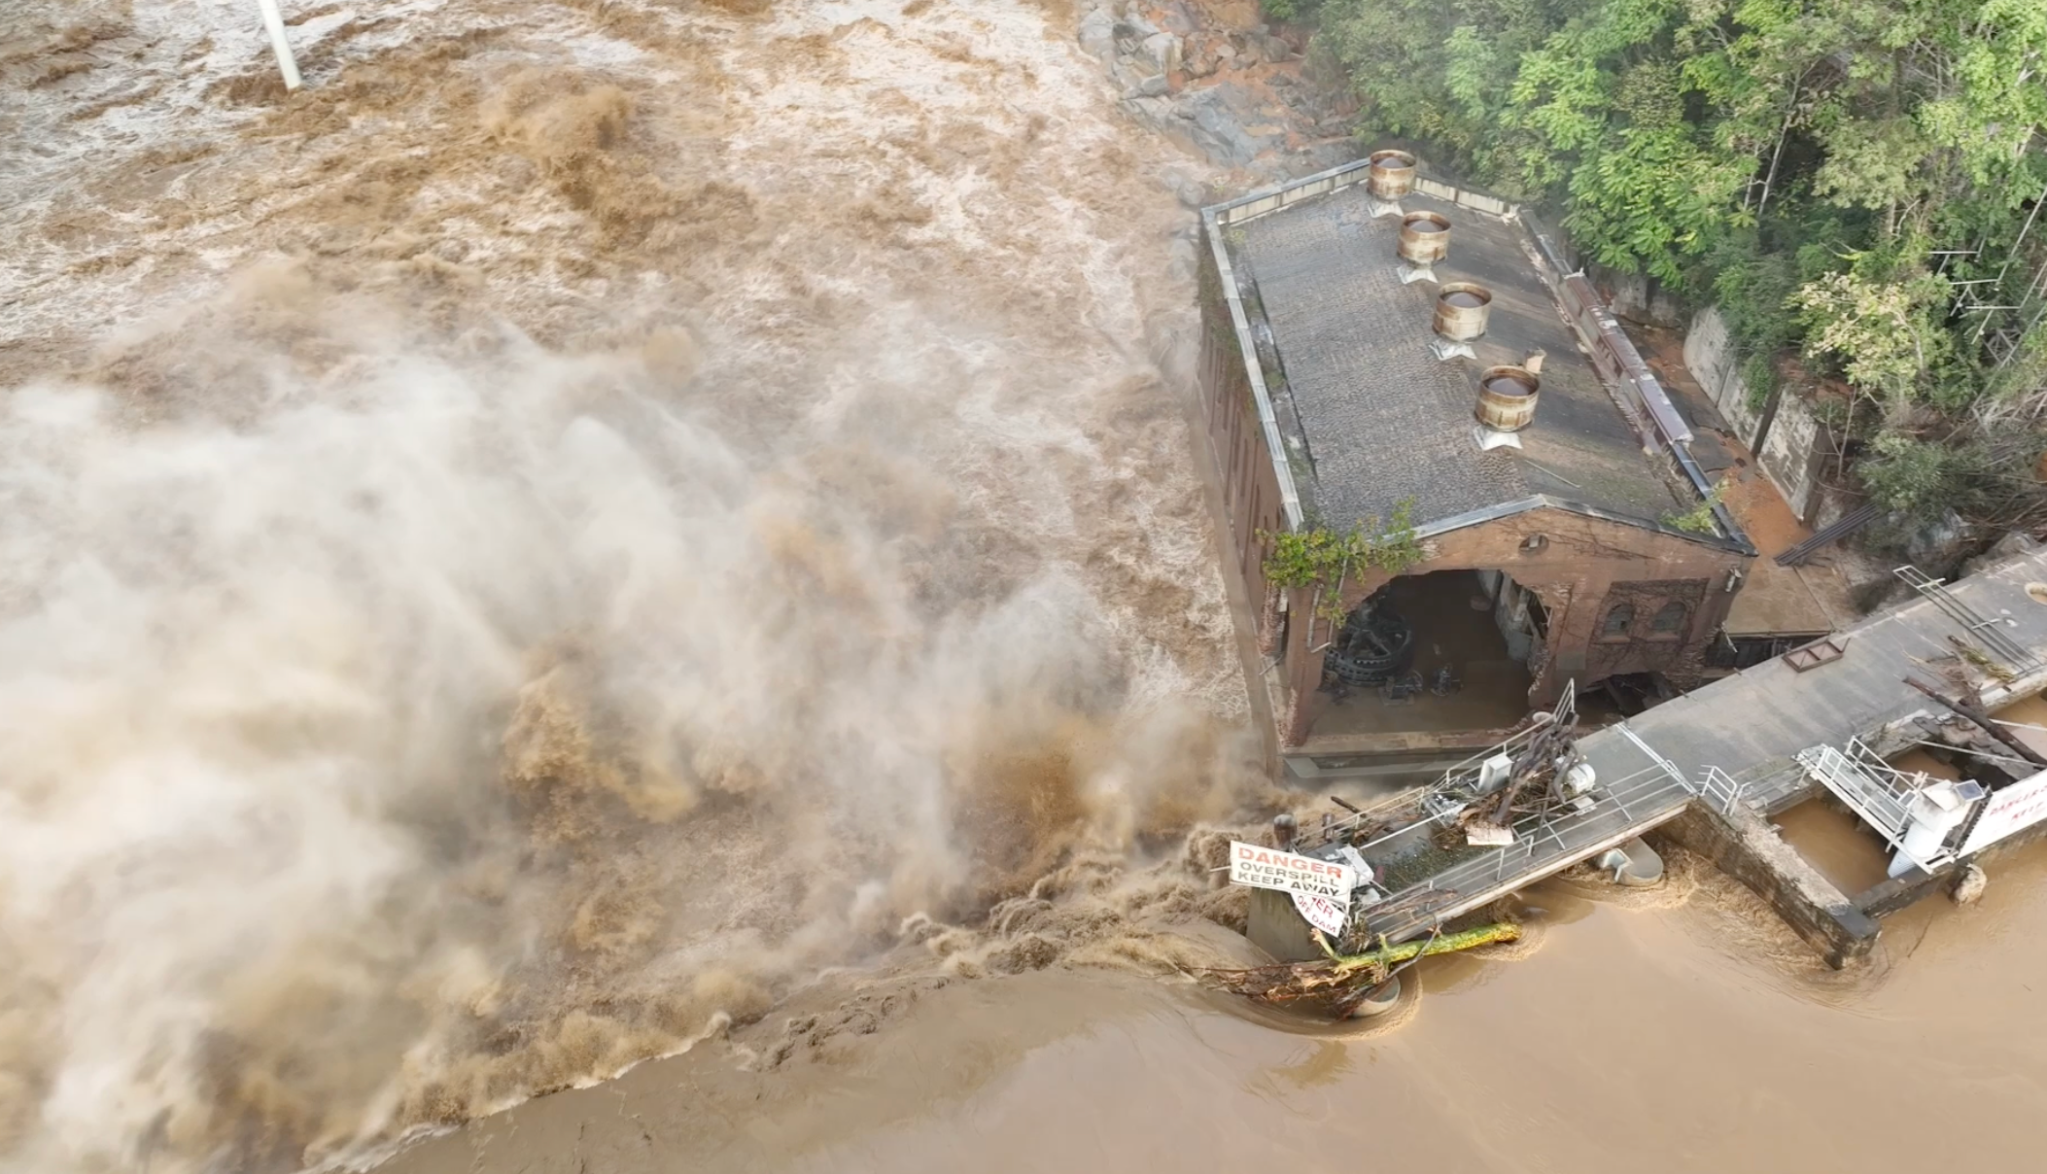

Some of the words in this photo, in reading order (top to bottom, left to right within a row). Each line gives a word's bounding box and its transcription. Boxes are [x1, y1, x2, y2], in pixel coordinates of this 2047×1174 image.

[1238, 847, 1342, 879] DANGER
[1240, 861, 1340, 888] OVERSPILL
[1238, 871, 1284, 885] KEEP
[1290, 881, 1341, 897] AWAY
[1312, 914, 1336, 932] DAM
